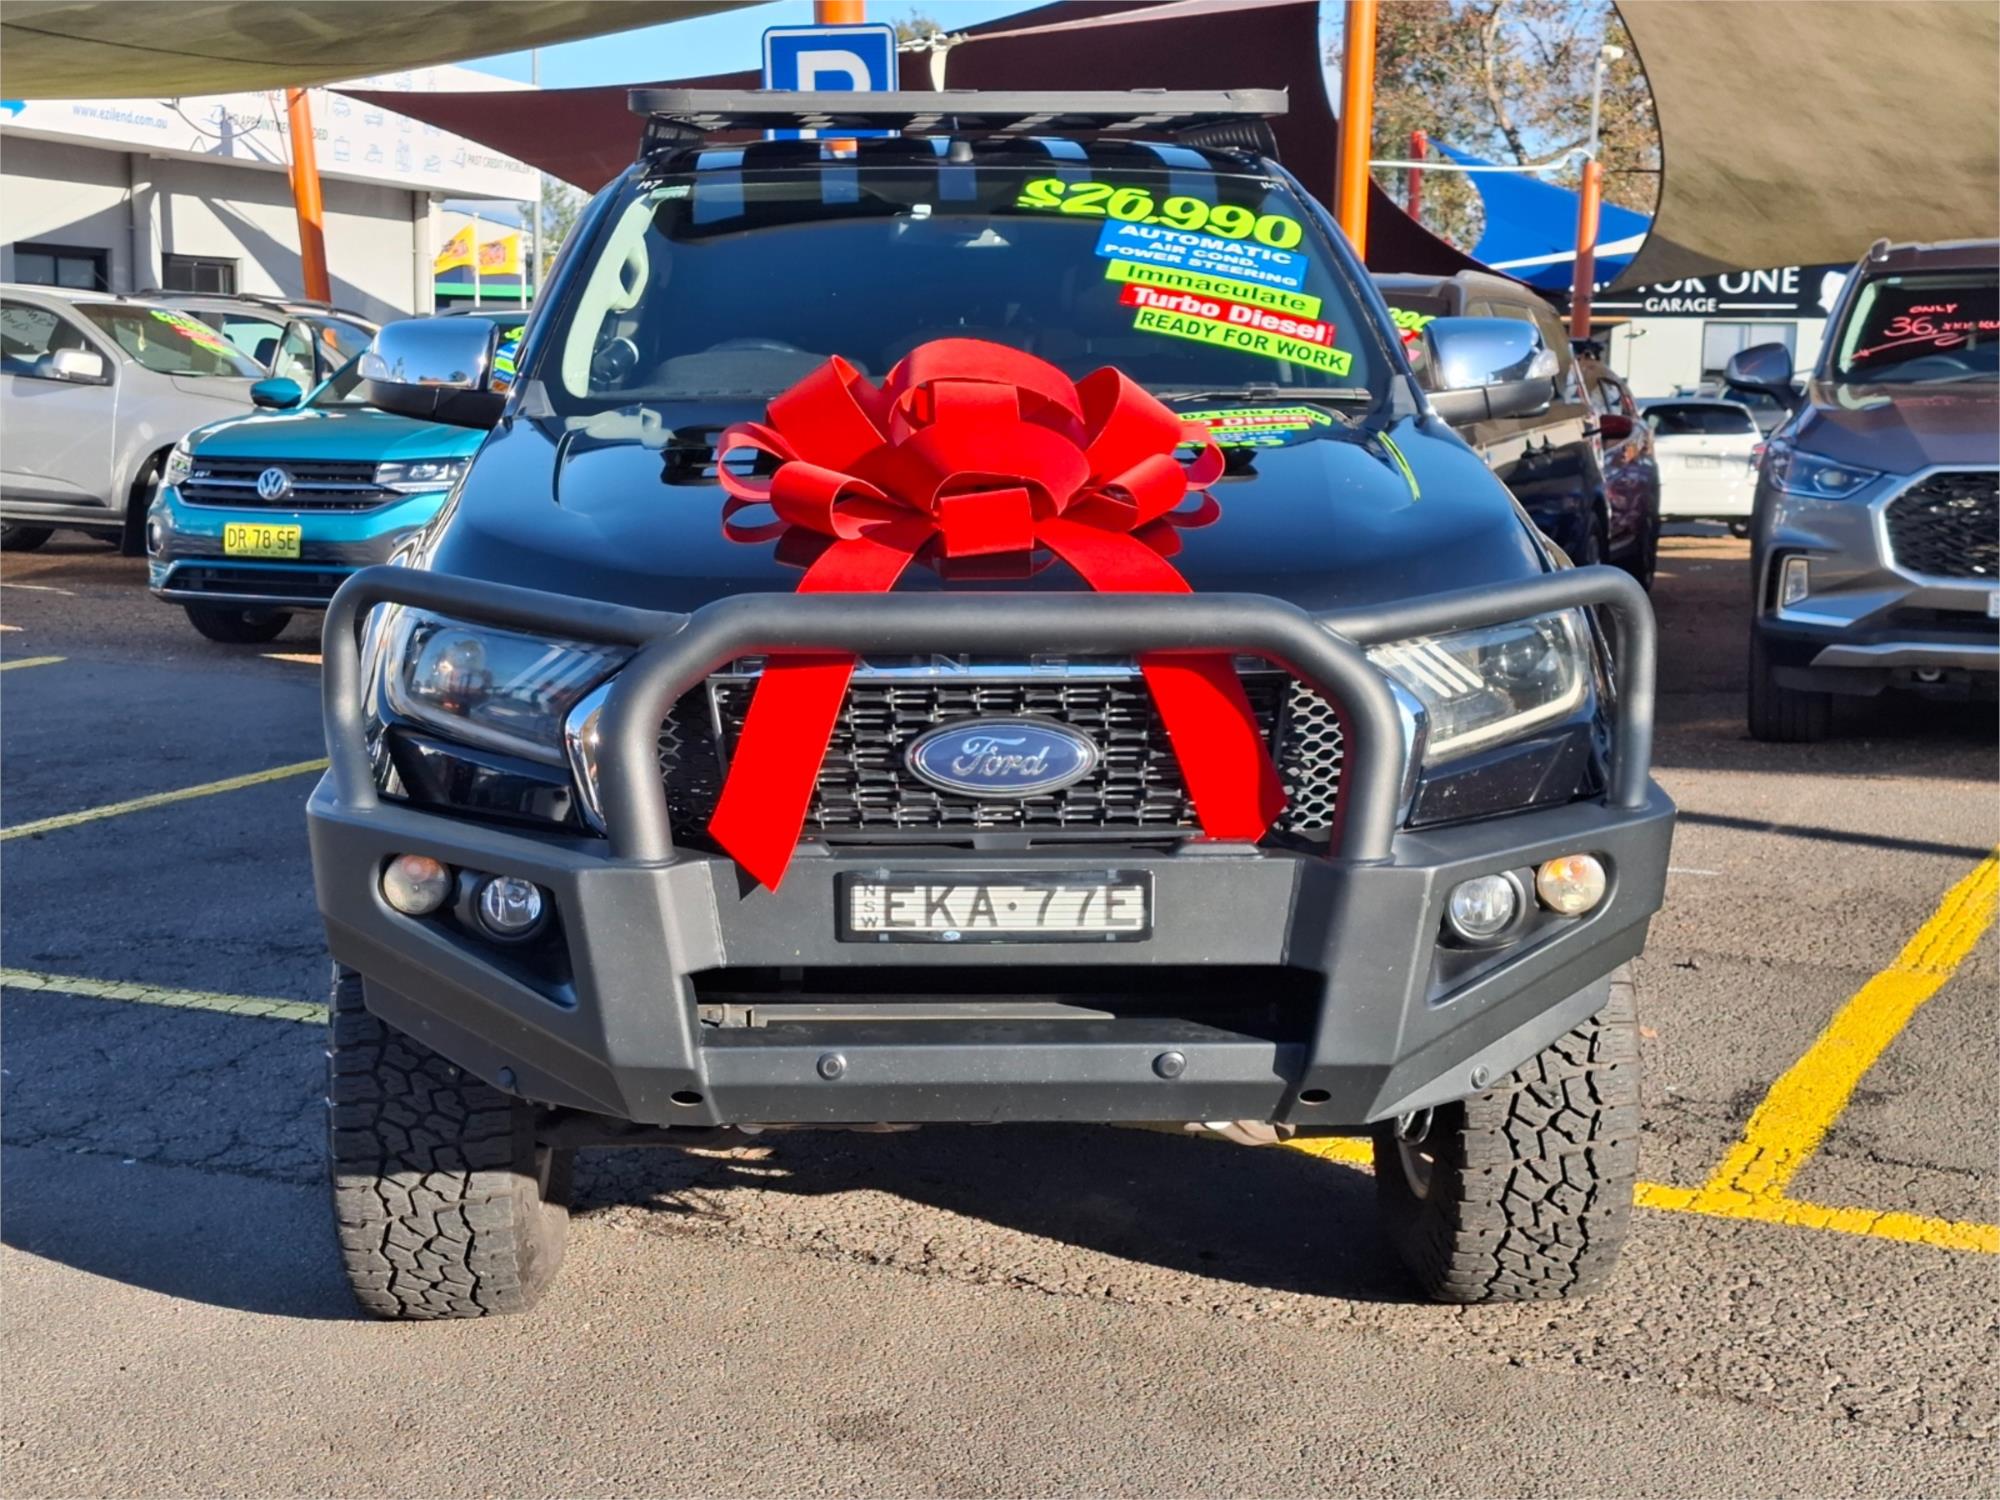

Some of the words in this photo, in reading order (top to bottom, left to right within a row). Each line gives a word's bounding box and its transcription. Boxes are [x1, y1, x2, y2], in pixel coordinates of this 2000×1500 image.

[72, 105, 168, 129] www.ezilend.com.au
[1118, 225, 1292, 265] AUTOMATIC
[1148, 242, 1186, 255] AIR
[1192, 249, 1259, 268] COND.
[1104, 244, 1182, 263] POWER
[1188, 258, 1298, 286] STEERING
[1718, 266, 1800, 294] ONE
[1127, 265, 1306, 311] Immaculate
[1644, 297, 1717, 313] GARAGE
[1133, 286, 1220, 317] Turbo
[1228, 304, 1326, 342] Diesel
[1909, 303, 1958, 314] ONLY
[1140, 311, 1217, 338] READY
[1223, 328, 1269, 351] FOR
[1277, 340, 1344, 370] WORK
[228, 528, 247, 548] DR
[253, 529, 272, 549] 78
[276, 530, 296, 551] SE
[952, 736, 1050, 776] Ford
